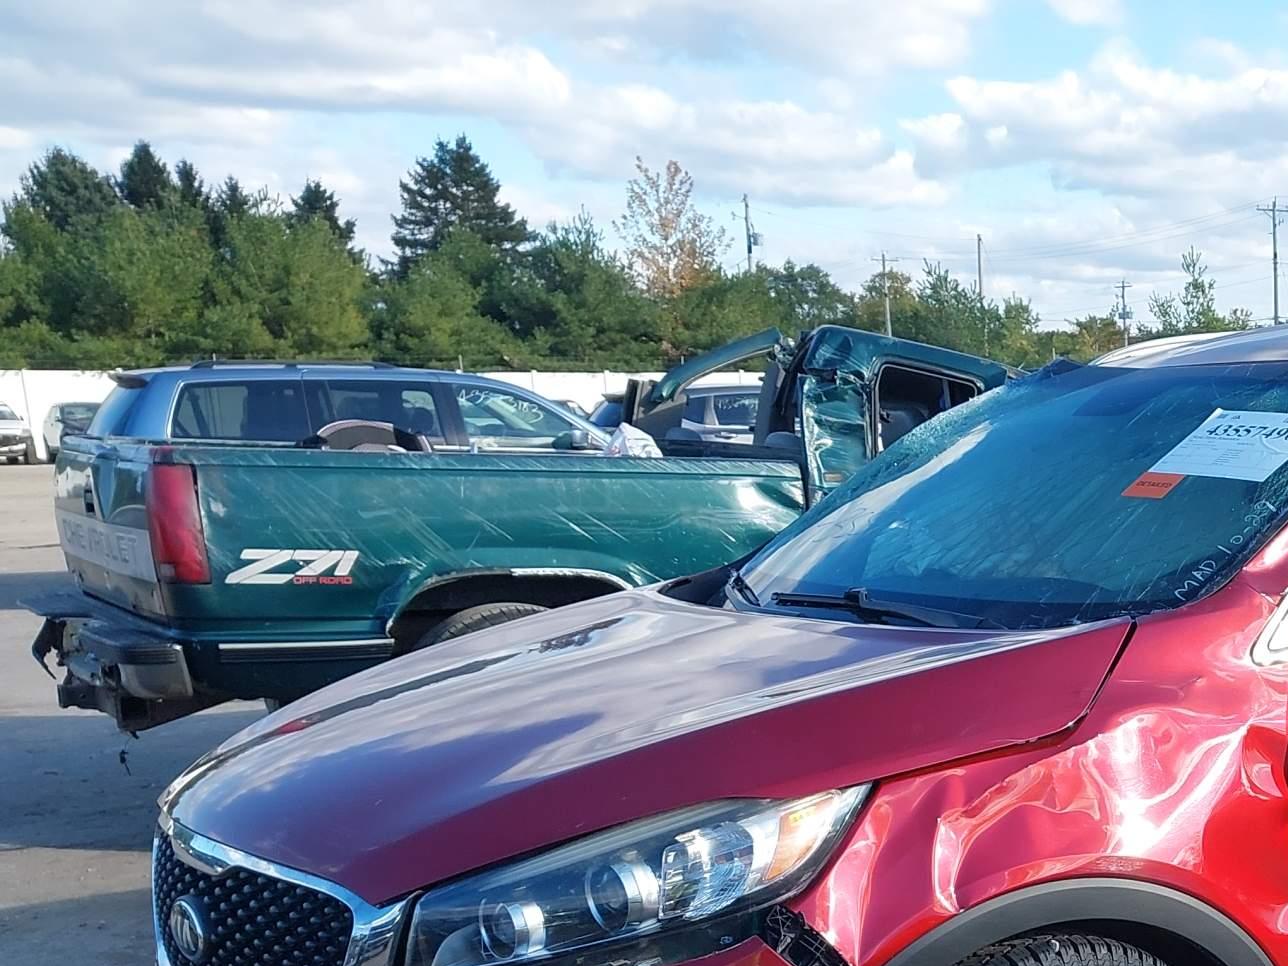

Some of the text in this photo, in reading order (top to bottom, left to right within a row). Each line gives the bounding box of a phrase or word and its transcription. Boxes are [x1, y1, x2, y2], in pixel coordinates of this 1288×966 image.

[224, 548, 360, 584] Z71
[293, 576, 353, 585] OFF ROAD
[1174, 560, 1216, 601] MAD
